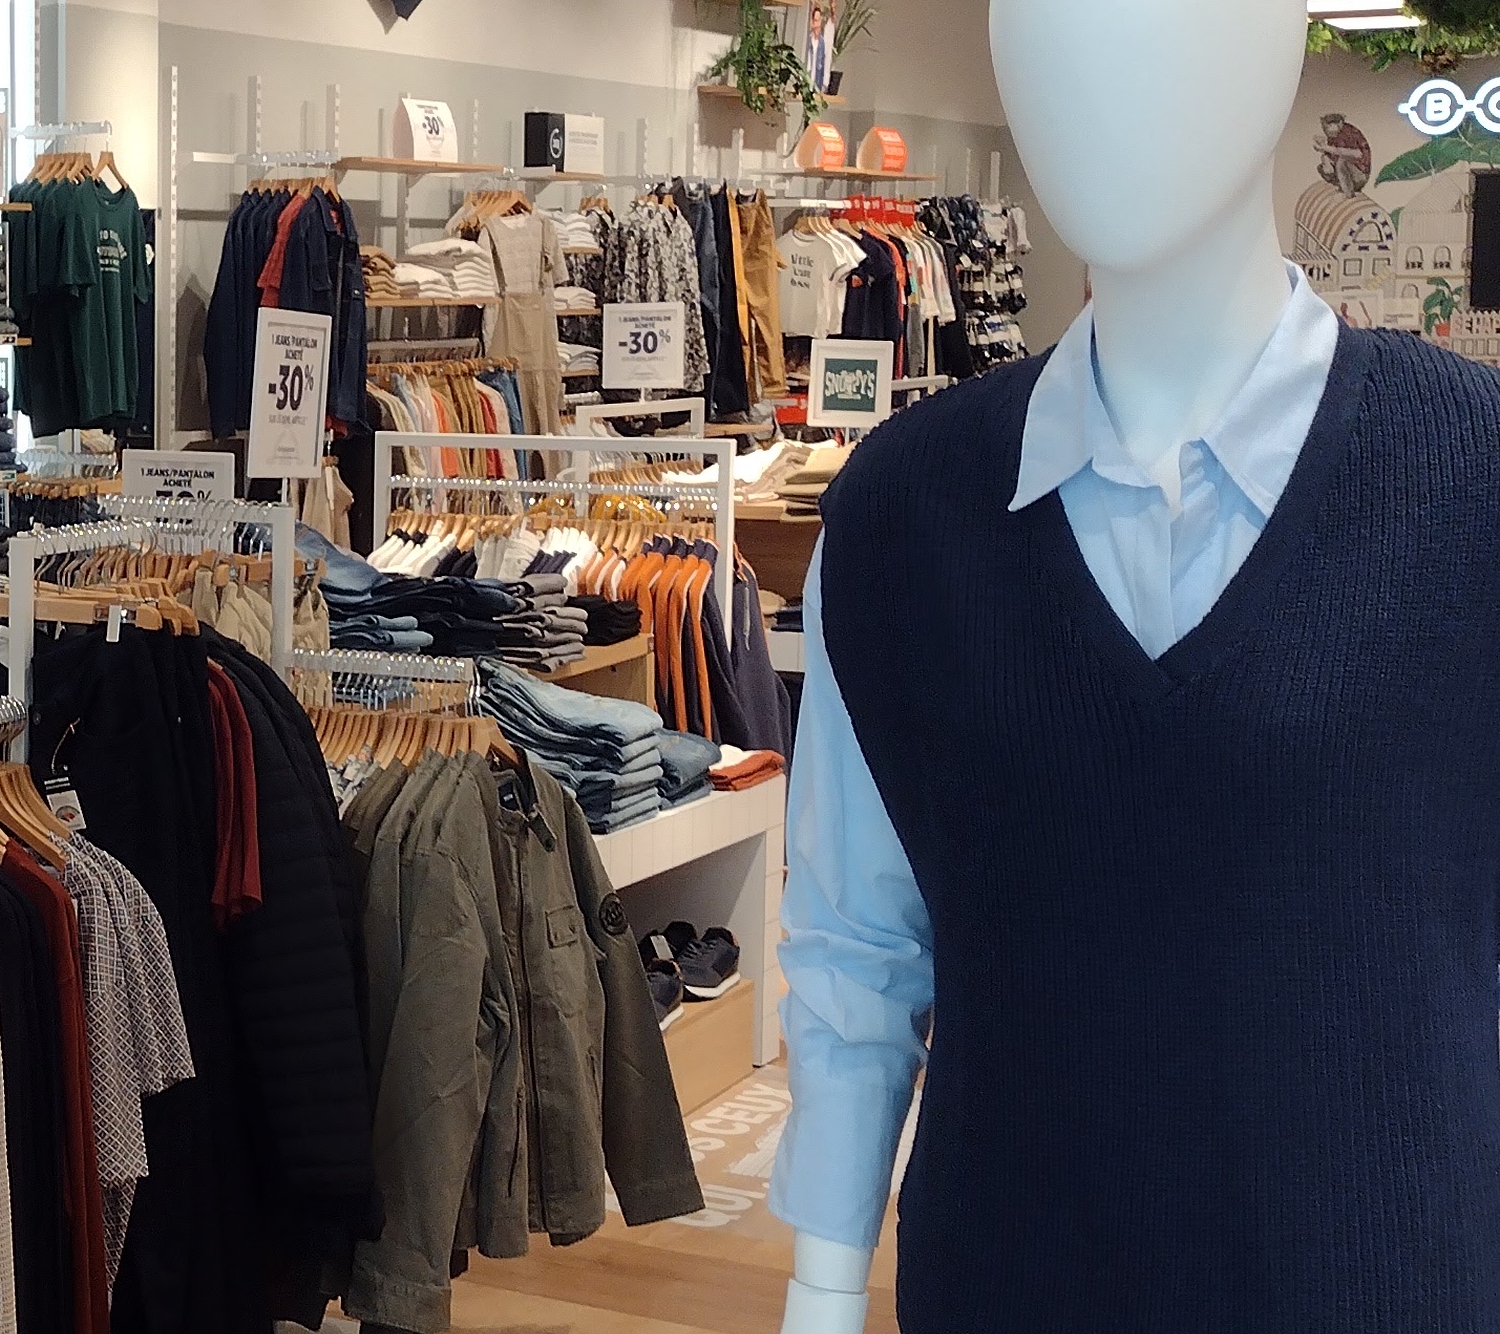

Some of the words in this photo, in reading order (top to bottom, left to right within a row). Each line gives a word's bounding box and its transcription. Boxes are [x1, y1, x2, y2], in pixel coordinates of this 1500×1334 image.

[618, 328, 672, 355] -30%
[267, 364, 315, 411] -30%
[145, 468, 215, 479] JEANS/PANTALON
